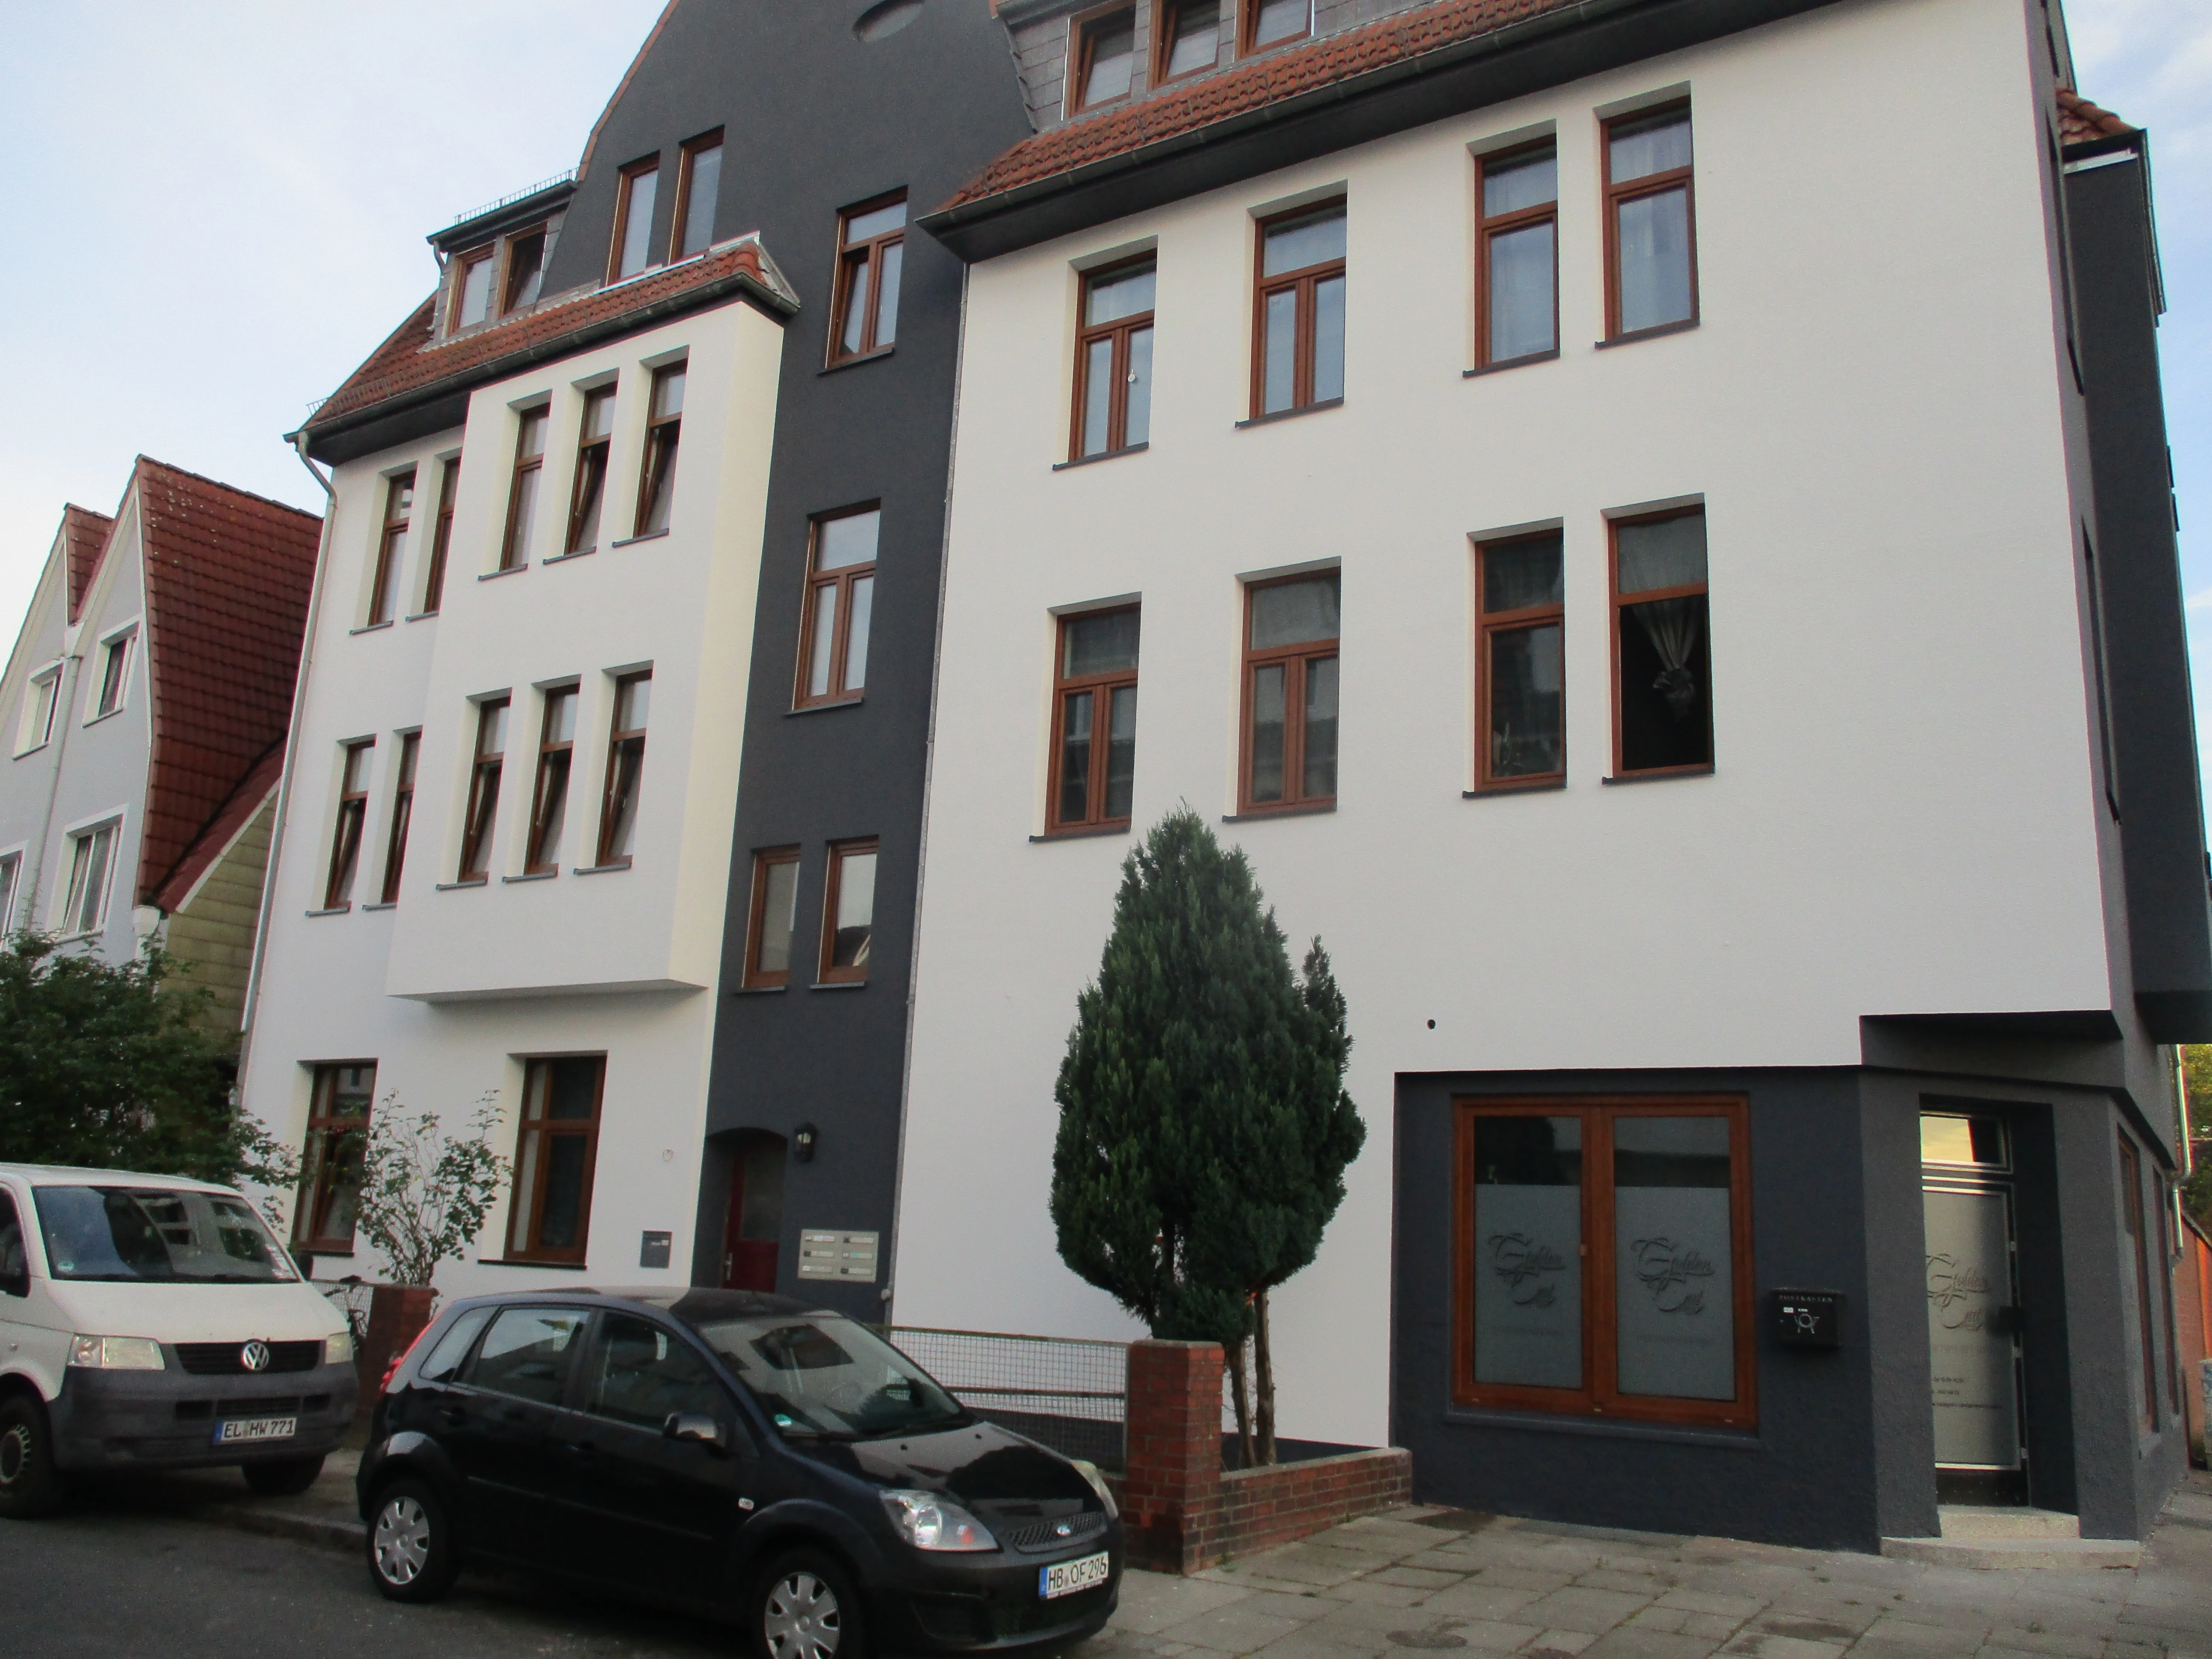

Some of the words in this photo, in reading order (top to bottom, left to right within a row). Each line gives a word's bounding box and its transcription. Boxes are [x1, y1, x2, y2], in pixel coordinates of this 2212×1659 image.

[1779, 1294, 1832, 1303] POSTKASTEN
[225, 1423, 242, 1438] EL
[250, 1422, 268, 1436] HW
[270, 1419, 294, 1435] 771
[1049, 1568, 1063, 1589] HB
[1071, 1562, 1086, 1583] OF
[1088, 1556, 1106, 1579] 296
